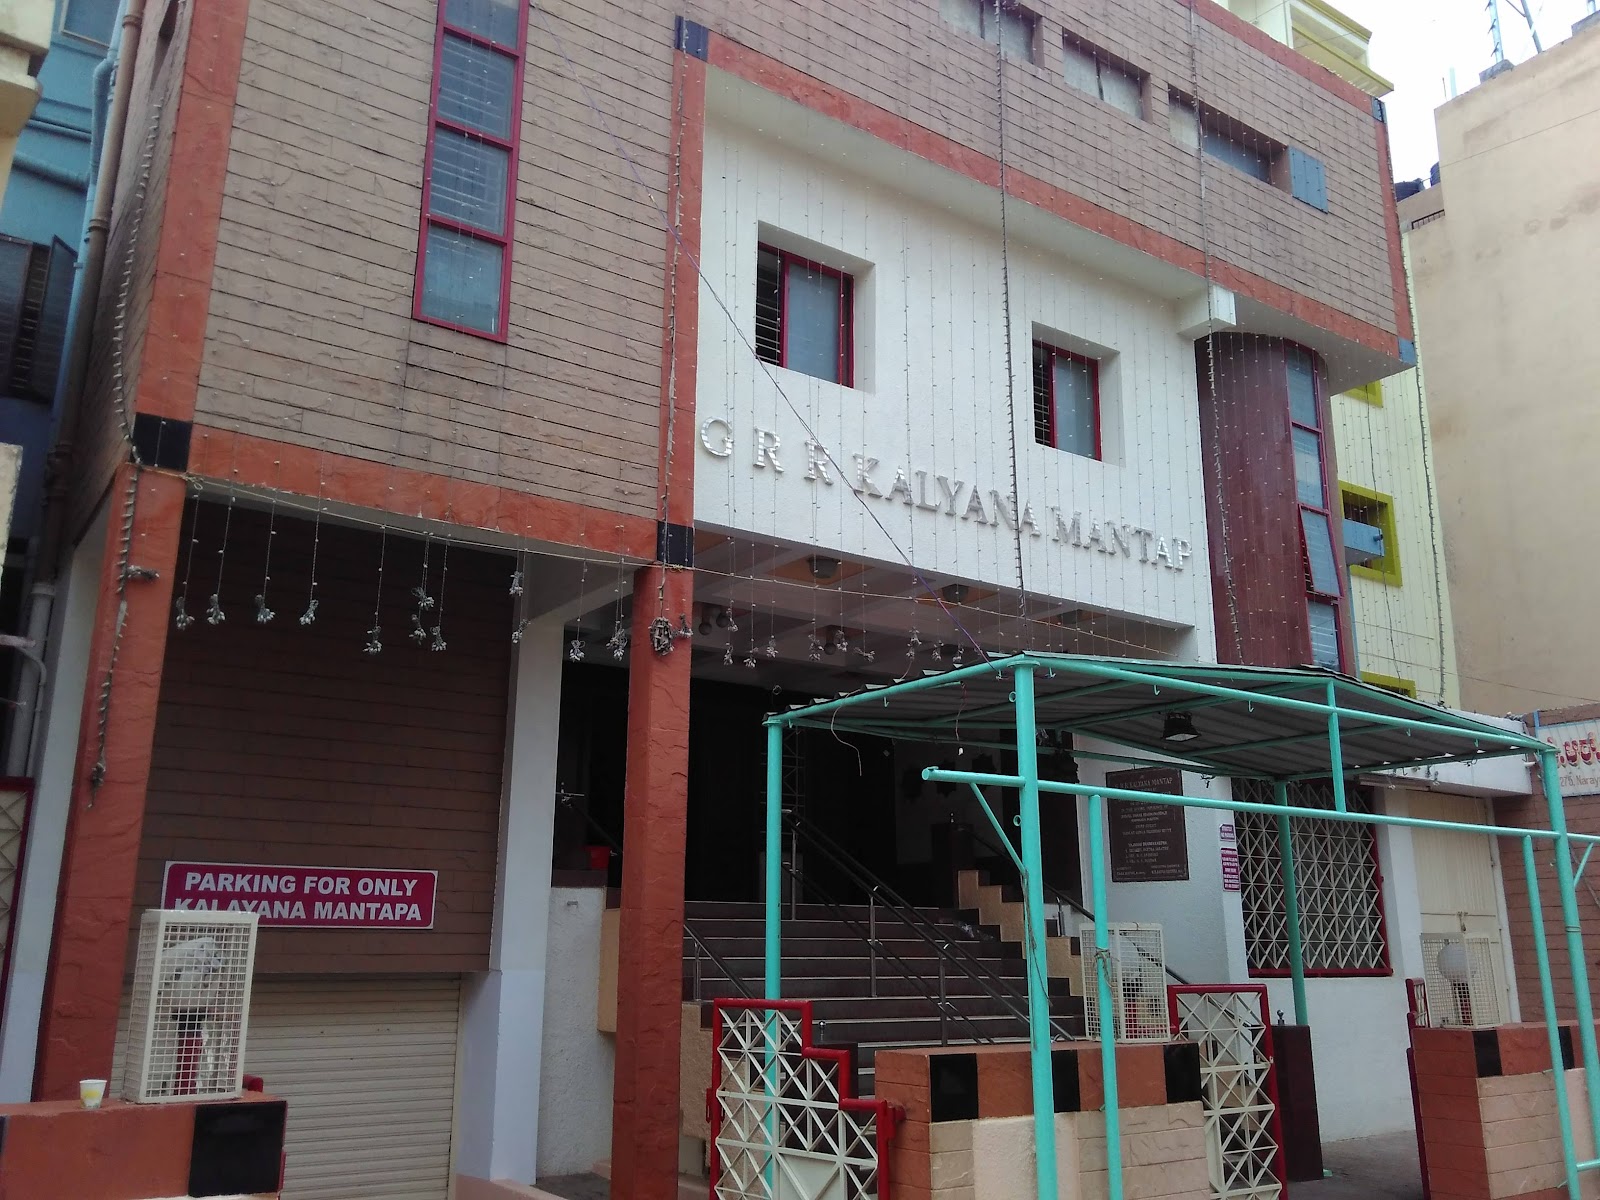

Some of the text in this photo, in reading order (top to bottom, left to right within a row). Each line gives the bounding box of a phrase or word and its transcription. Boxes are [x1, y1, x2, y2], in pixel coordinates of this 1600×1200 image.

[700, 416, 1192, 571] G R R KALYANA MANTAP
[185, 872, 417, 896] PARKING FOR ONLY
[313, 902, 422, 921] MANTAPA
